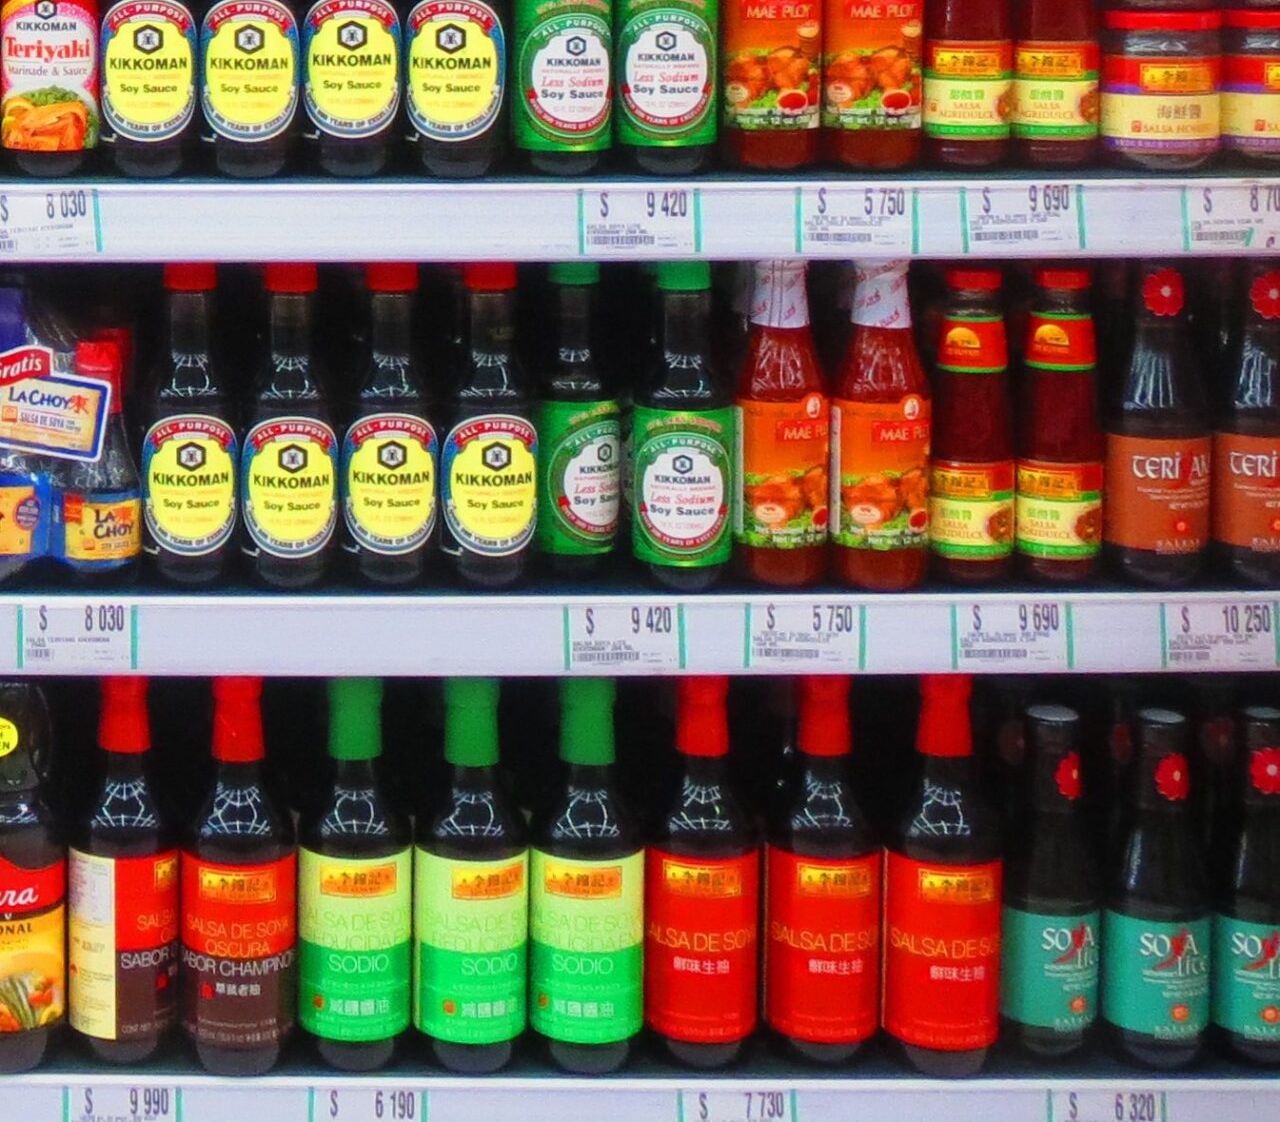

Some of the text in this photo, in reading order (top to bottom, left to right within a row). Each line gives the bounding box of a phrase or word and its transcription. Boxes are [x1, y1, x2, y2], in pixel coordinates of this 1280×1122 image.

[746, 6, 776, 20] MAE
[15, 21, 77, 32] KIKKOMAN
[4, 36, 90, 62] Teriyaki
[109, 56, 188, 71] KIKKOMAN
[209, 57, 288, 71] KIKKOMAN
[312, 53, 391, 68] KIKKOMAN
[412, 55, 491, 70] KIKKOMAN
[547, 56, 601, 67] KIKKOMAN
[8, 65, 89, 76] Marinade & Sauce
[633, 71, 699, 83] Less Sodium
[120, 83, 177, 95] Soy Sauce
[322, 79, 381, 92] Soy Sauce
[633, 83, 699, 97] Soy Sauce
[153, 471, 229, 486] KIKKOMAN
[253, 474, 330, 489] KIKKOMAN
[353, 470, 430, 485] KIKKOMAN
[455, 471, 533, 486] KIKKOMAN
[650, 492, 715, 504] Less Sodium
[649, 505, 715, 517] Soy Sauce
[231, 923, 254, 939] DE
[206, 941, 270, 956] OSCURA
[328, 953, 389, 973] SODIO
[462, 954, 517, 976] SODIO
[552, 954, 614, 974] SODIO
